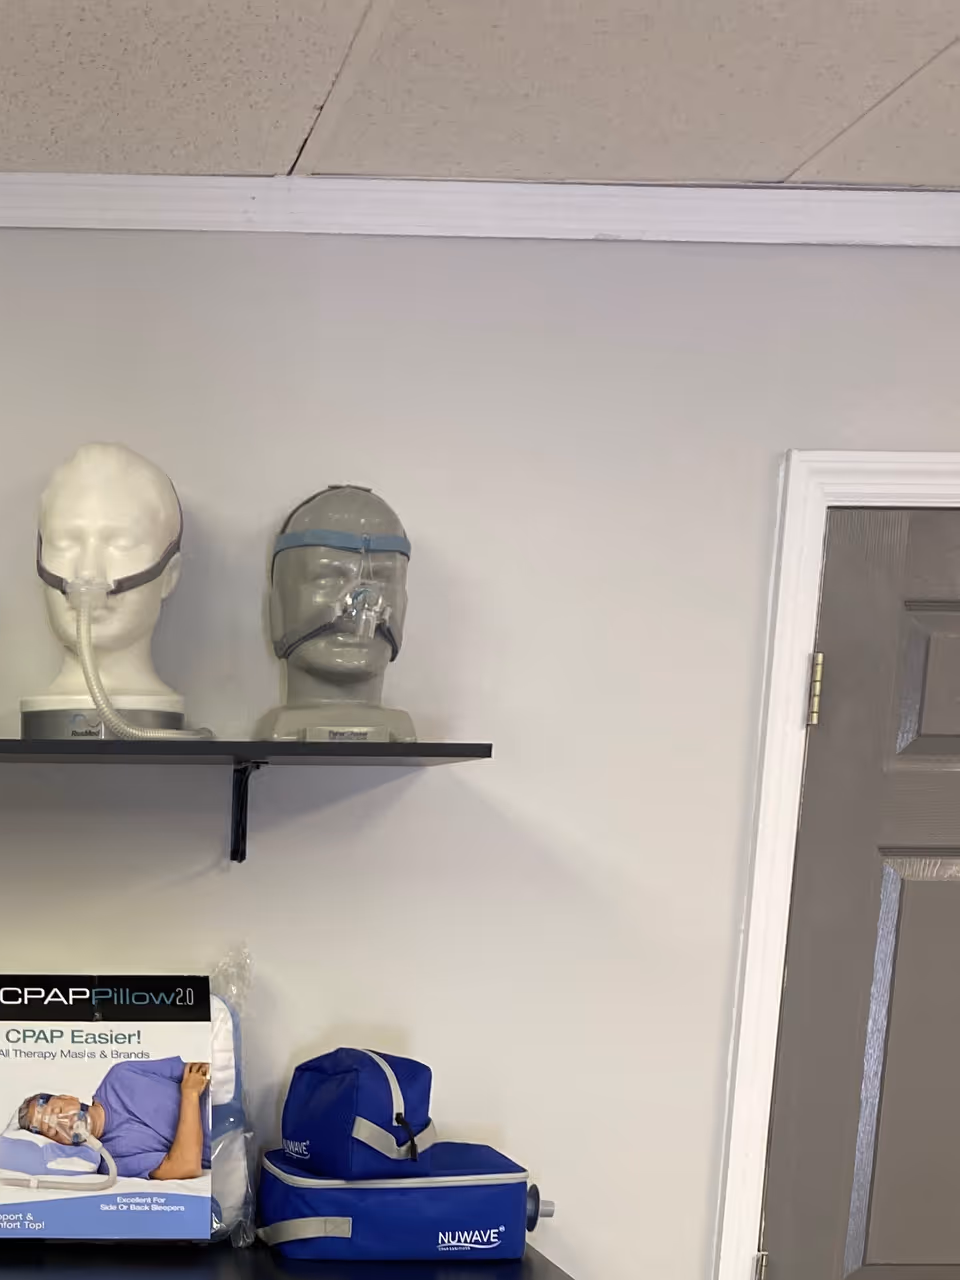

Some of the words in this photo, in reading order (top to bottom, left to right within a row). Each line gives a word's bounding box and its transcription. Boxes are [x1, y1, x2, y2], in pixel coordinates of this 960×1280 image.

[5, 1028, 64, 1044] CPAP
[71, 1029, 142, 1045] Easier!
[12, 1049, 57, 1061] Therapy
[60, 1050, 96, 1060] Masks
[99, 1051, 108, 1060] &
[111, 1051, 150, 1060] Brands
[116, 1196, 152, 1204] Excellent
[100, 1203, 117, 1211] Side
[118, 1203, 129, 1211] Or
[130, 1203, 150, 1211] Back
[150, 1204, 185, 1212] Sleepers
[25, 1213, 34, 1221] &
[24, 1221, 45, 1230] Top!
